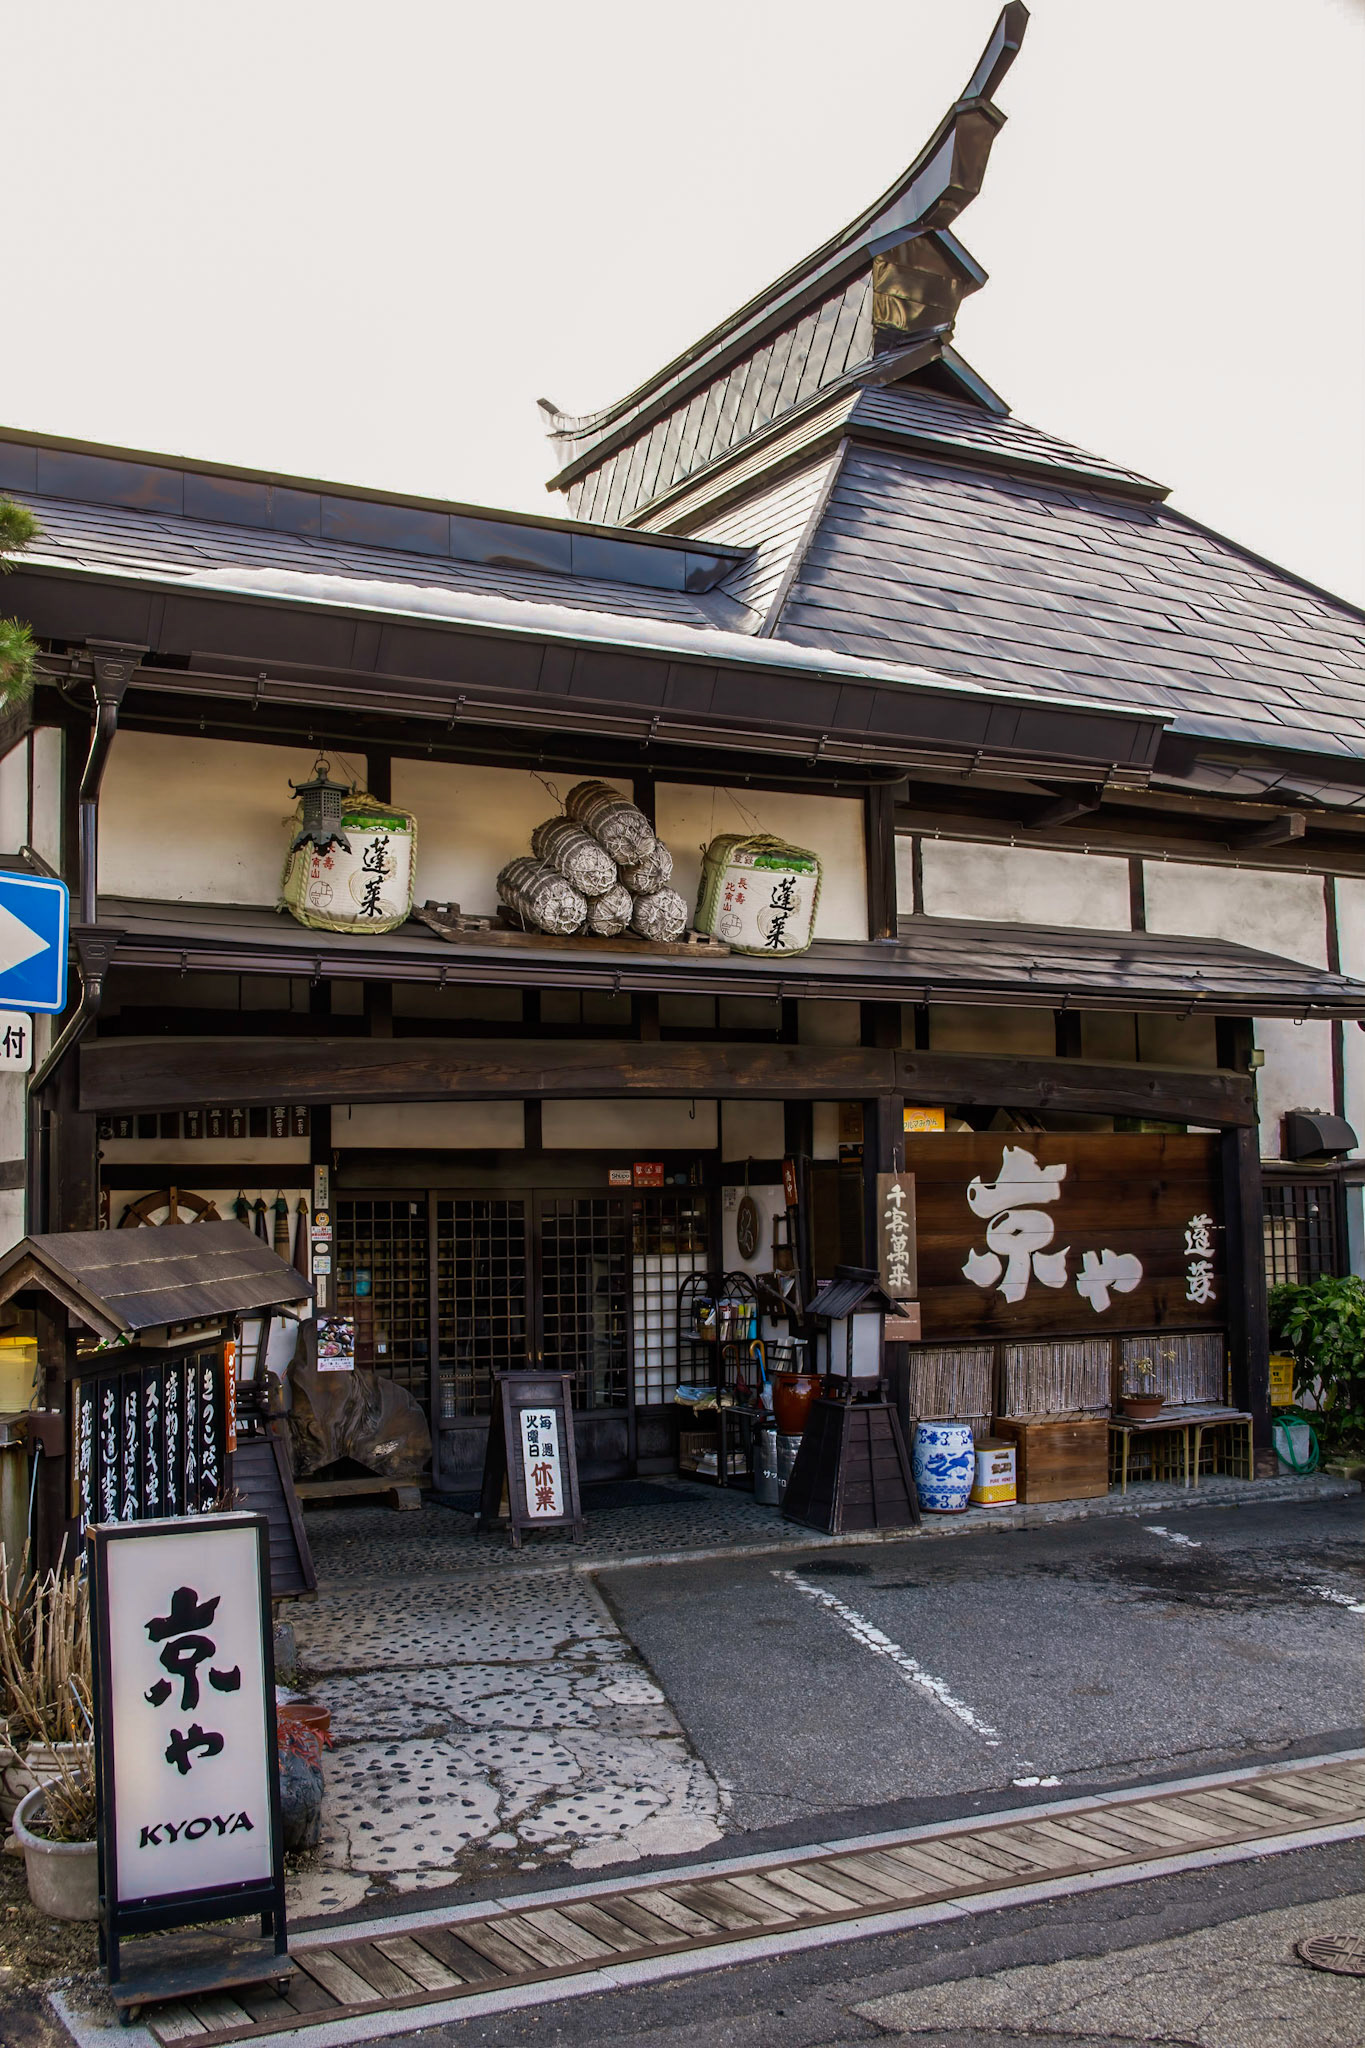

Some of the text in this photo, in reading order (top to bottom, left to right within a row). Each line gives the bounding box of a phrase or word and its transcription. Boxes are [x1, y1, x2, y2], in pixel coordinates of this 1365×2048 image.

[0, 1026, 26, 1058] 付
[961, 1145, 1143, 1313] 京や
[526, 1415, 540, 1457] 火曜日
[530, 1461, 557, 1512] 休業
[143, 1585, 242, 1776] 京や
[139, 1809, 255, 1849] KYOYA
